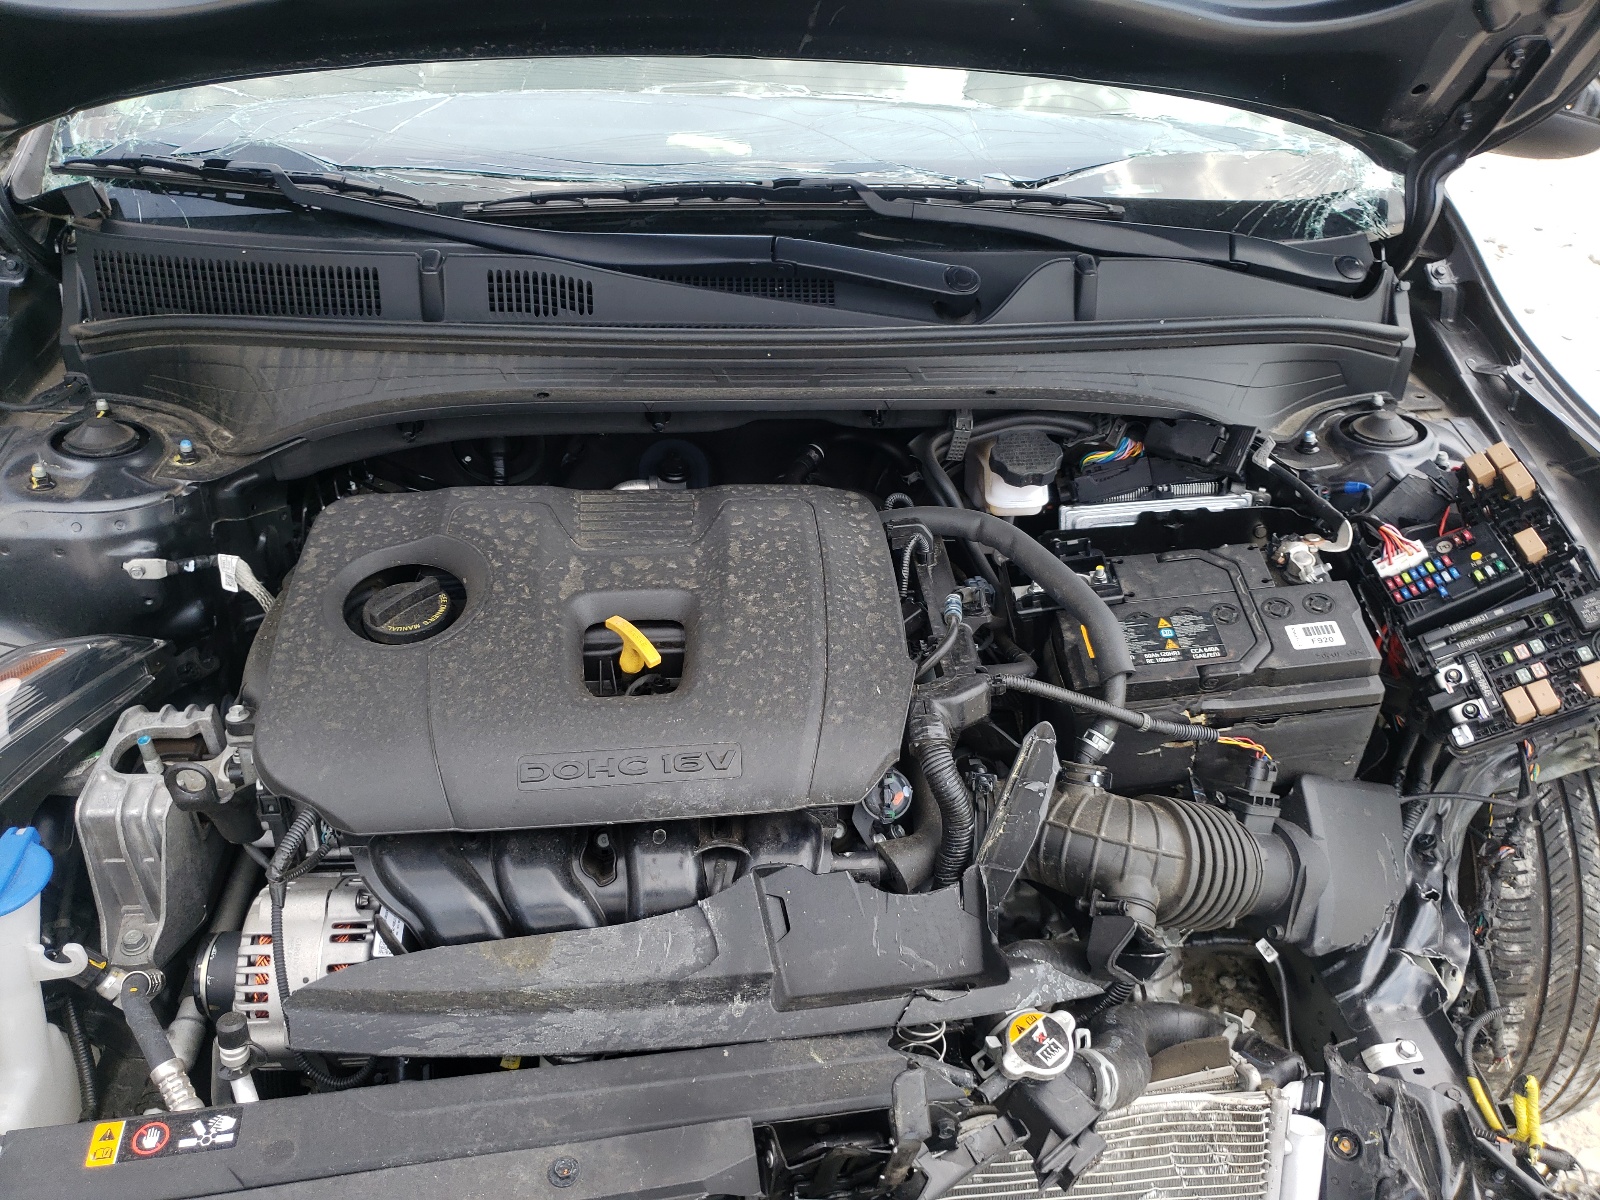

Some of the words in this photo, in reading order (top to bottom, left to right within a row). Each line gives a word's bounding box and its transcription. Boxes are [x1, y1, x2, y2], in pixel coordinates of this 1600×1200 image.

[388, 623, 421, 632] MANUAL
[1311, 636, 1335, 645] F920
[520, 755, 649, 784] DOHC
[661, 750, 737, 774] 16V
